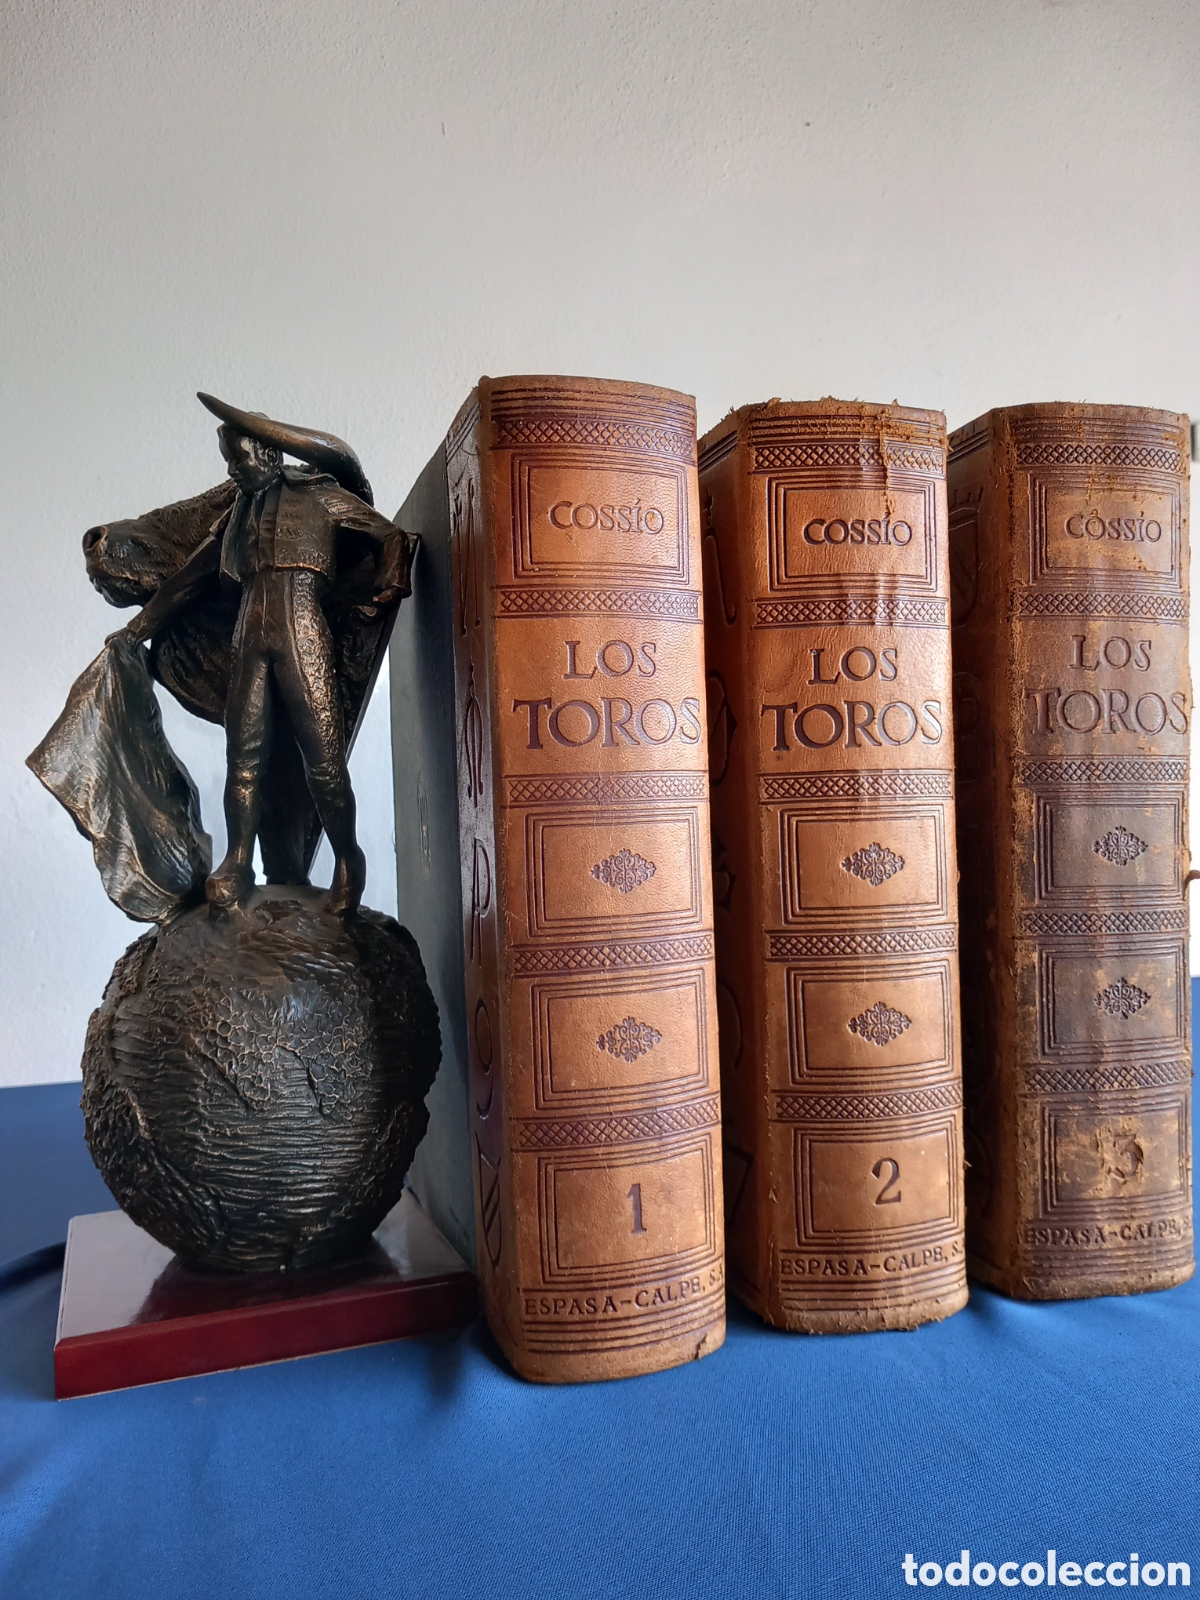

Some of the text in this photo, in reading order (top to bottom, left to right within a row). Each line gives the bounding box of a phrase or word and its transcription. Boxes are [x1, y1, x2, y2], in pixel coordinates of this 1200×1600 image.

[549, 498, 664, 535] COSSÍO
[803, 512, 913, 546] COSSÍO
[1064, 511, 1162, 542] COSSÍO
[563, 640, 657, 680] LOS
[808, 646, 898, 685] LOS
[1068, 635, 1152, 672] LOS
[512, 696, 700, 750] TOROS
[761, 700, 943, 751] TOROS
[1025, 688, 1188, 736] TOROS
[871, 1157, 902, 1206] 2
[626, 1183, 647, 1235] 1
